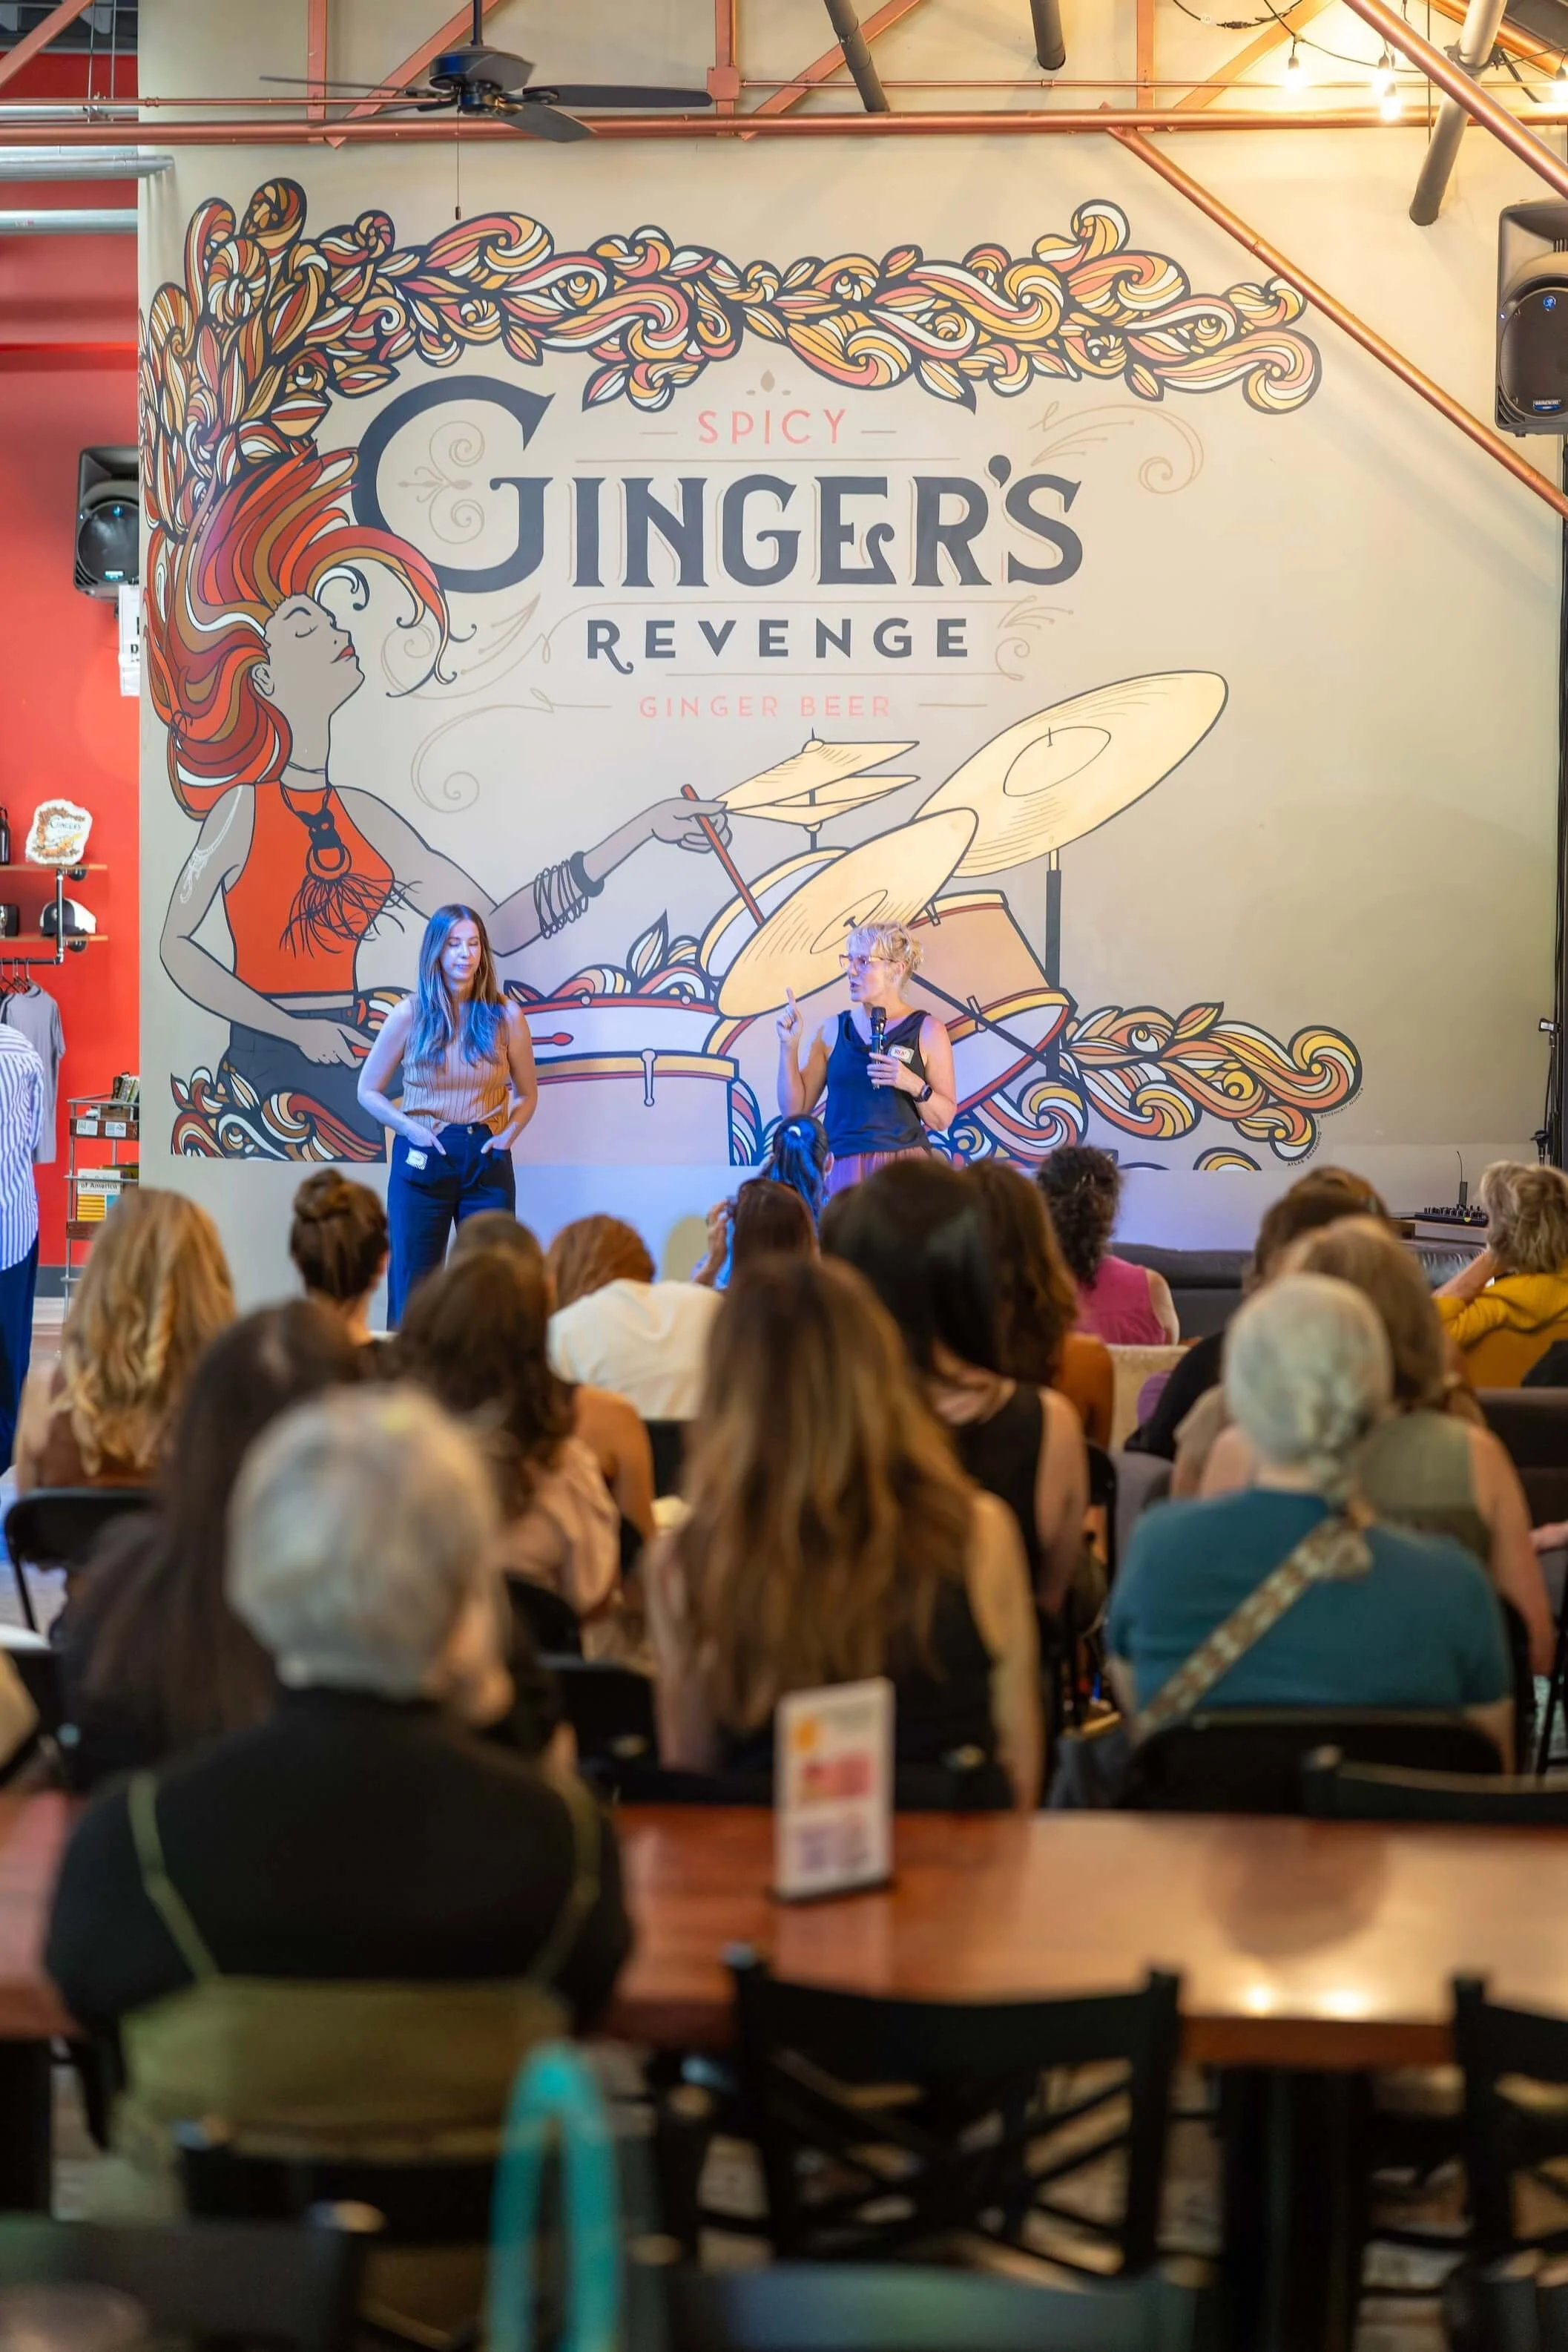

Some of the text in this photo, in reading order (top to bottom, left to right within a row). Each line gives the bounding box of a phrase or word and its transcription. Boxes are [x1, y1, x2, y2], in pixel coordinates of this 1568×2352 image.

[697, 408, 846, 444] SPICY
[350, 375, 1083, 594] GINGER'S
[587, 617, 969, 674] REVENGE
[639, 694, 890, 719] GINGER BEER
